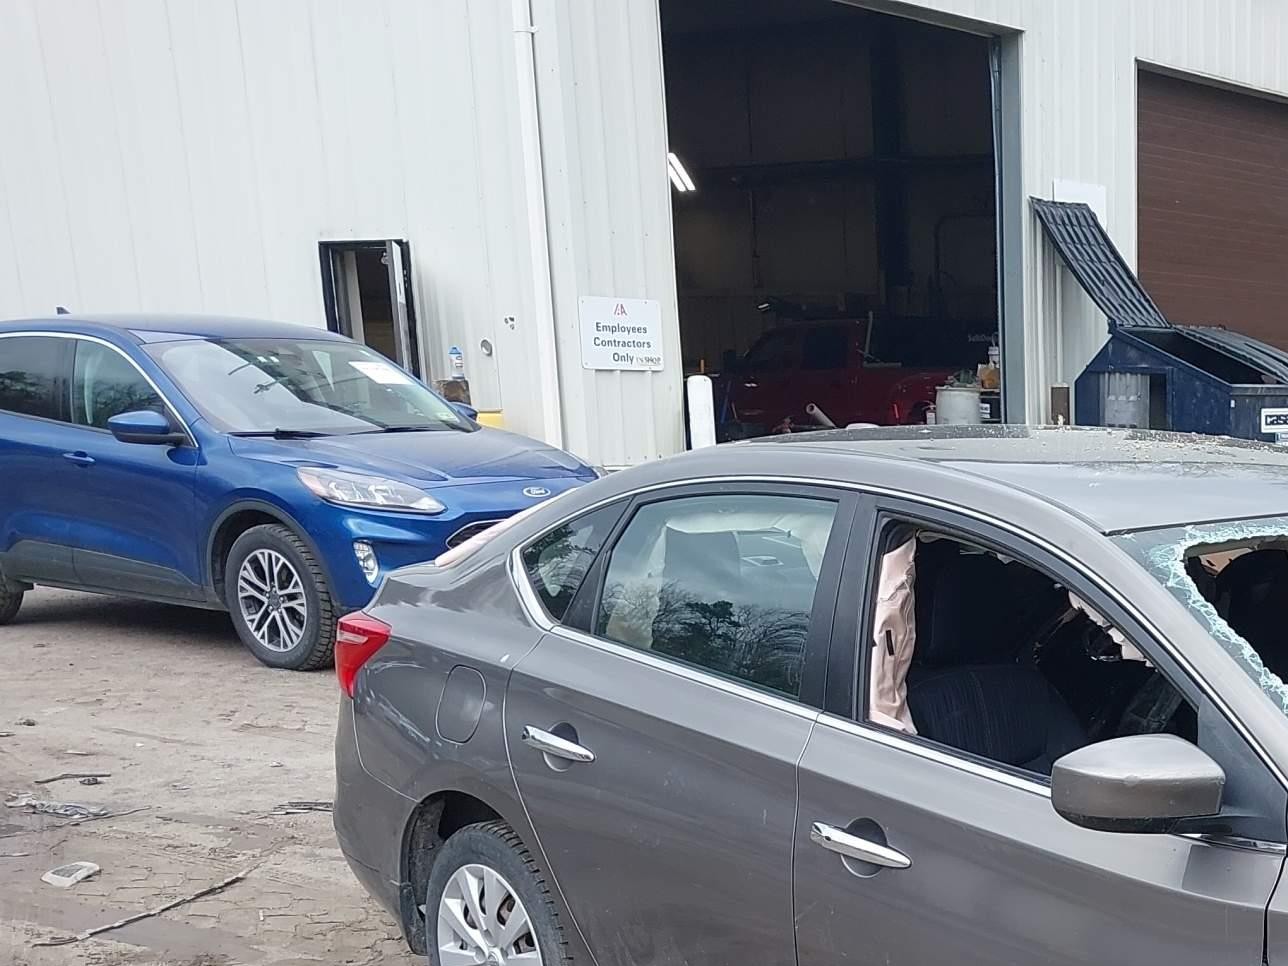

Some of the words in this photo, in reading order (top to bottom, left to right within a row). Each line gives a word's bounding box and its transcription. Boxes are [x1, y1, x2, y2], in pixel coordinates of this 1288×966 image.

[595, 321, 648, 335] Employees
[593, 336, 652, 348] Contractors
[612, 352, 635, 364] Only
